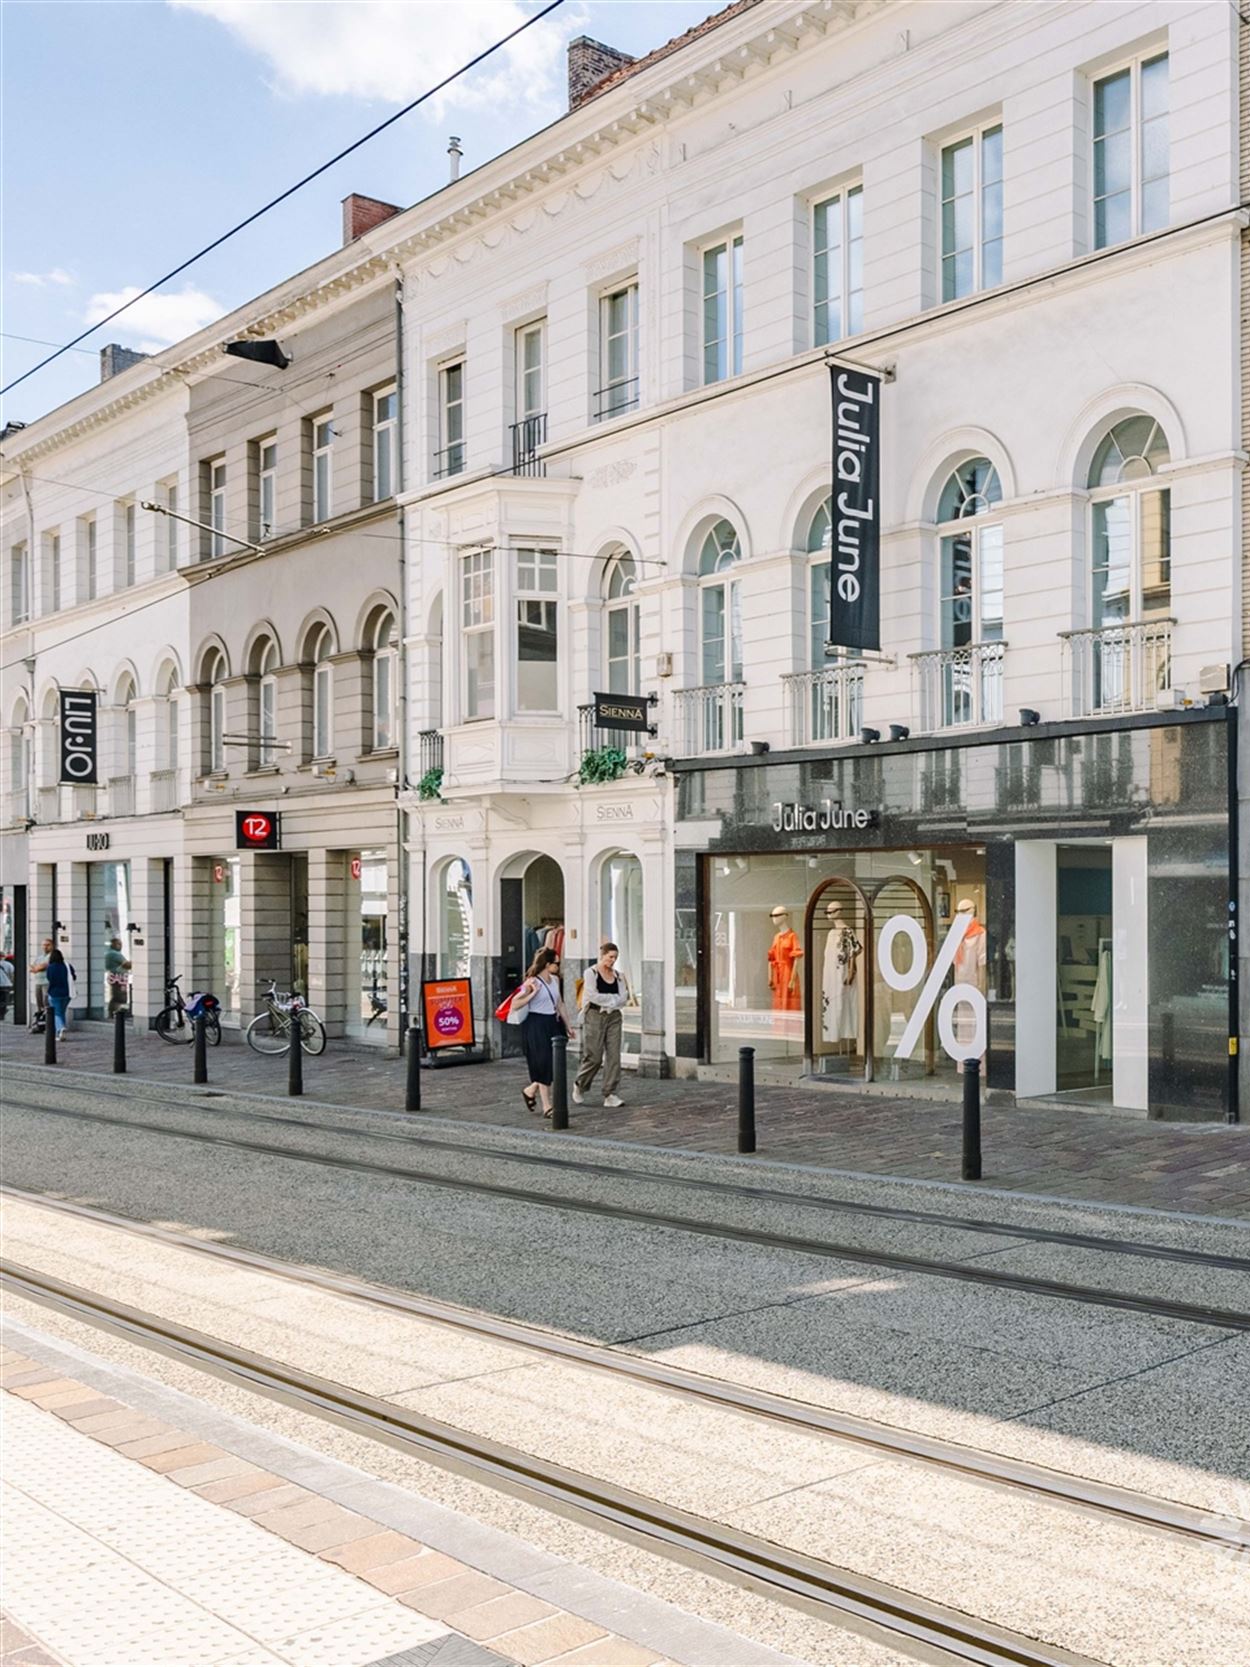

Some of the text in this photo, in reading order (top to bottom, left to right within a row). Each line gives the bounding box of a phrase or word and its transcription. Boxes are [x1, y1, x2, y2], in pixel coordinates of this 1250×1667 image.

[837, 373, 873, 602] Julia June
[599, 704, 643, 720] SIENNA
[596, 804, 634, 819] SIENNA
[773, 798, 868, 832] Julia June
[438, 1016, 460, 1027] 50%
